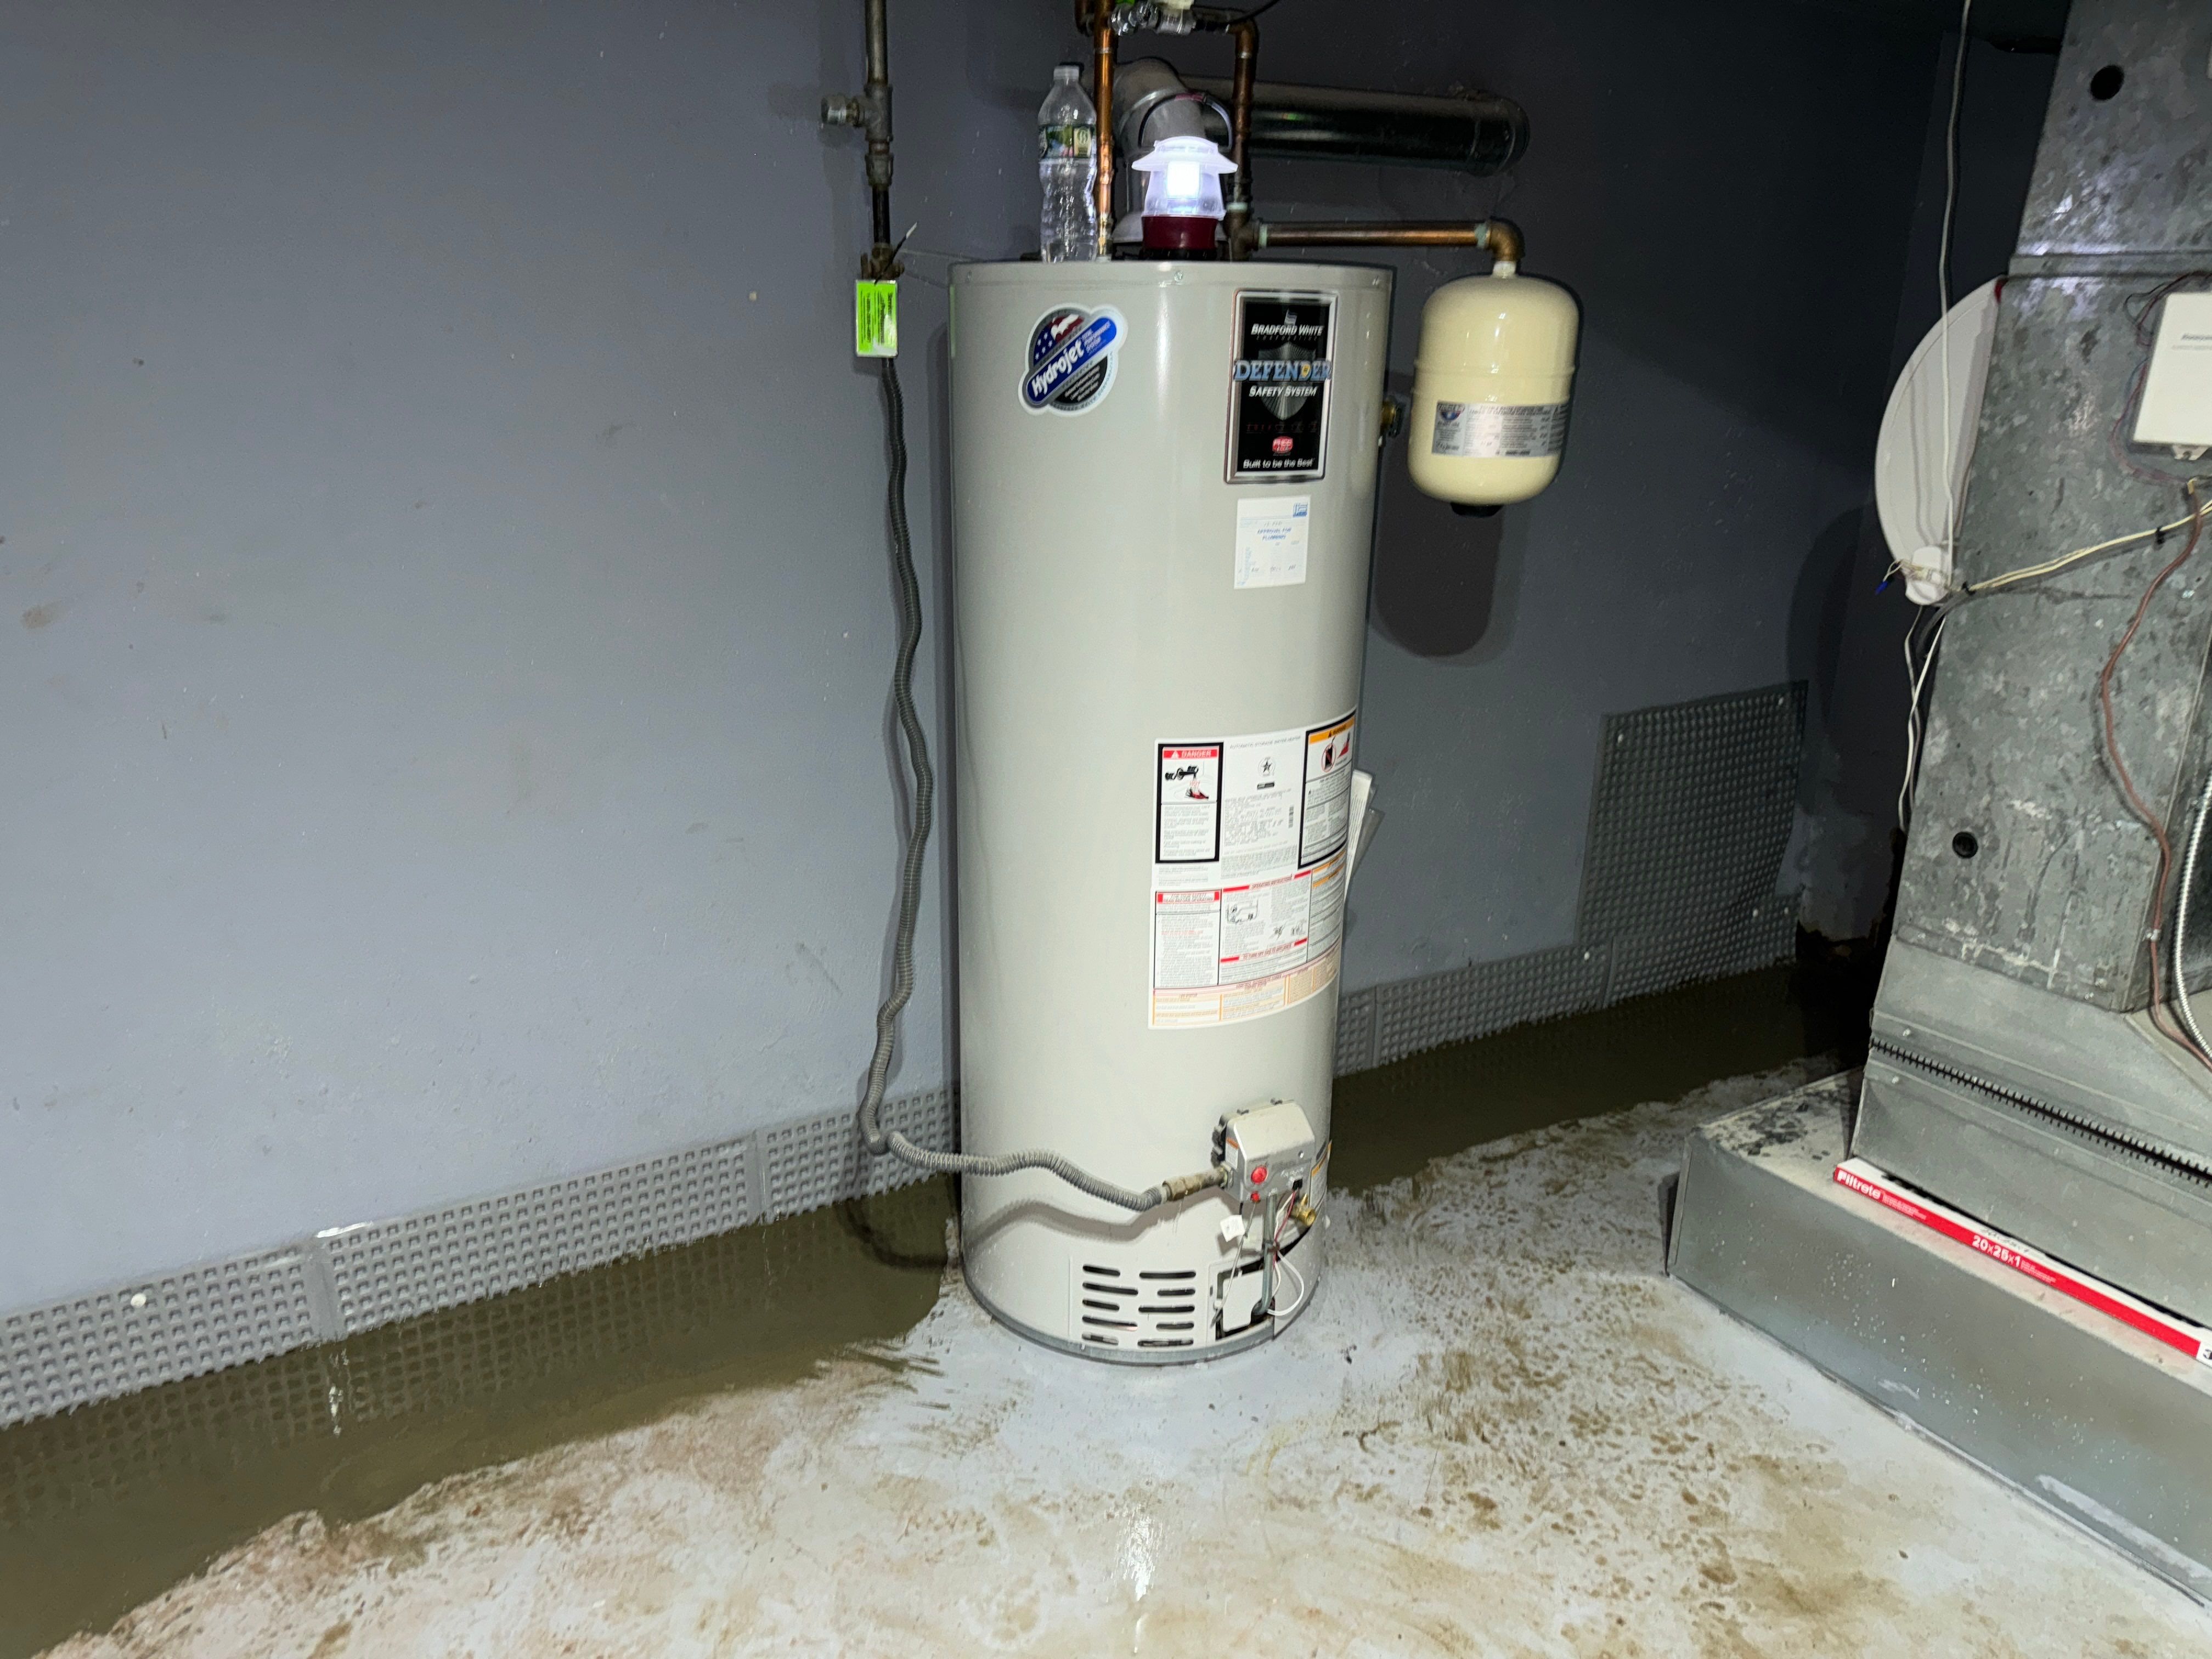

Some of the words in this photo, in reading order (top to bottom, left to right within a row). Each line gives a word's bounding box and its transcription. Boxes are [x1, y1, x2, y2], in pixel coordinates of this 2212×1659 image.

[1251, 323, 1298, 336] BRADFORD
[1298, 324, 1324, 336] WHITE
[1031, 338, 1085, 398] Hydrojet
[1233, 360, 1332, 381] DEFENDER
[1249, 385, 1284, 397] SAFETY
[1284, 386, 1318, 397] SYSTEM
[1243, 459, 1261, 469] Built
[1262, 460, 1272, 469] to
[1272, 459, 1283, 468] be
[1284, 459, 1296, 467] the
[1181, 749, 1212, 758] DANGER
[1837, 1169, 1882, 1200] Filtrete
[1972, 1234, 2021, 1267] 20x25x1
